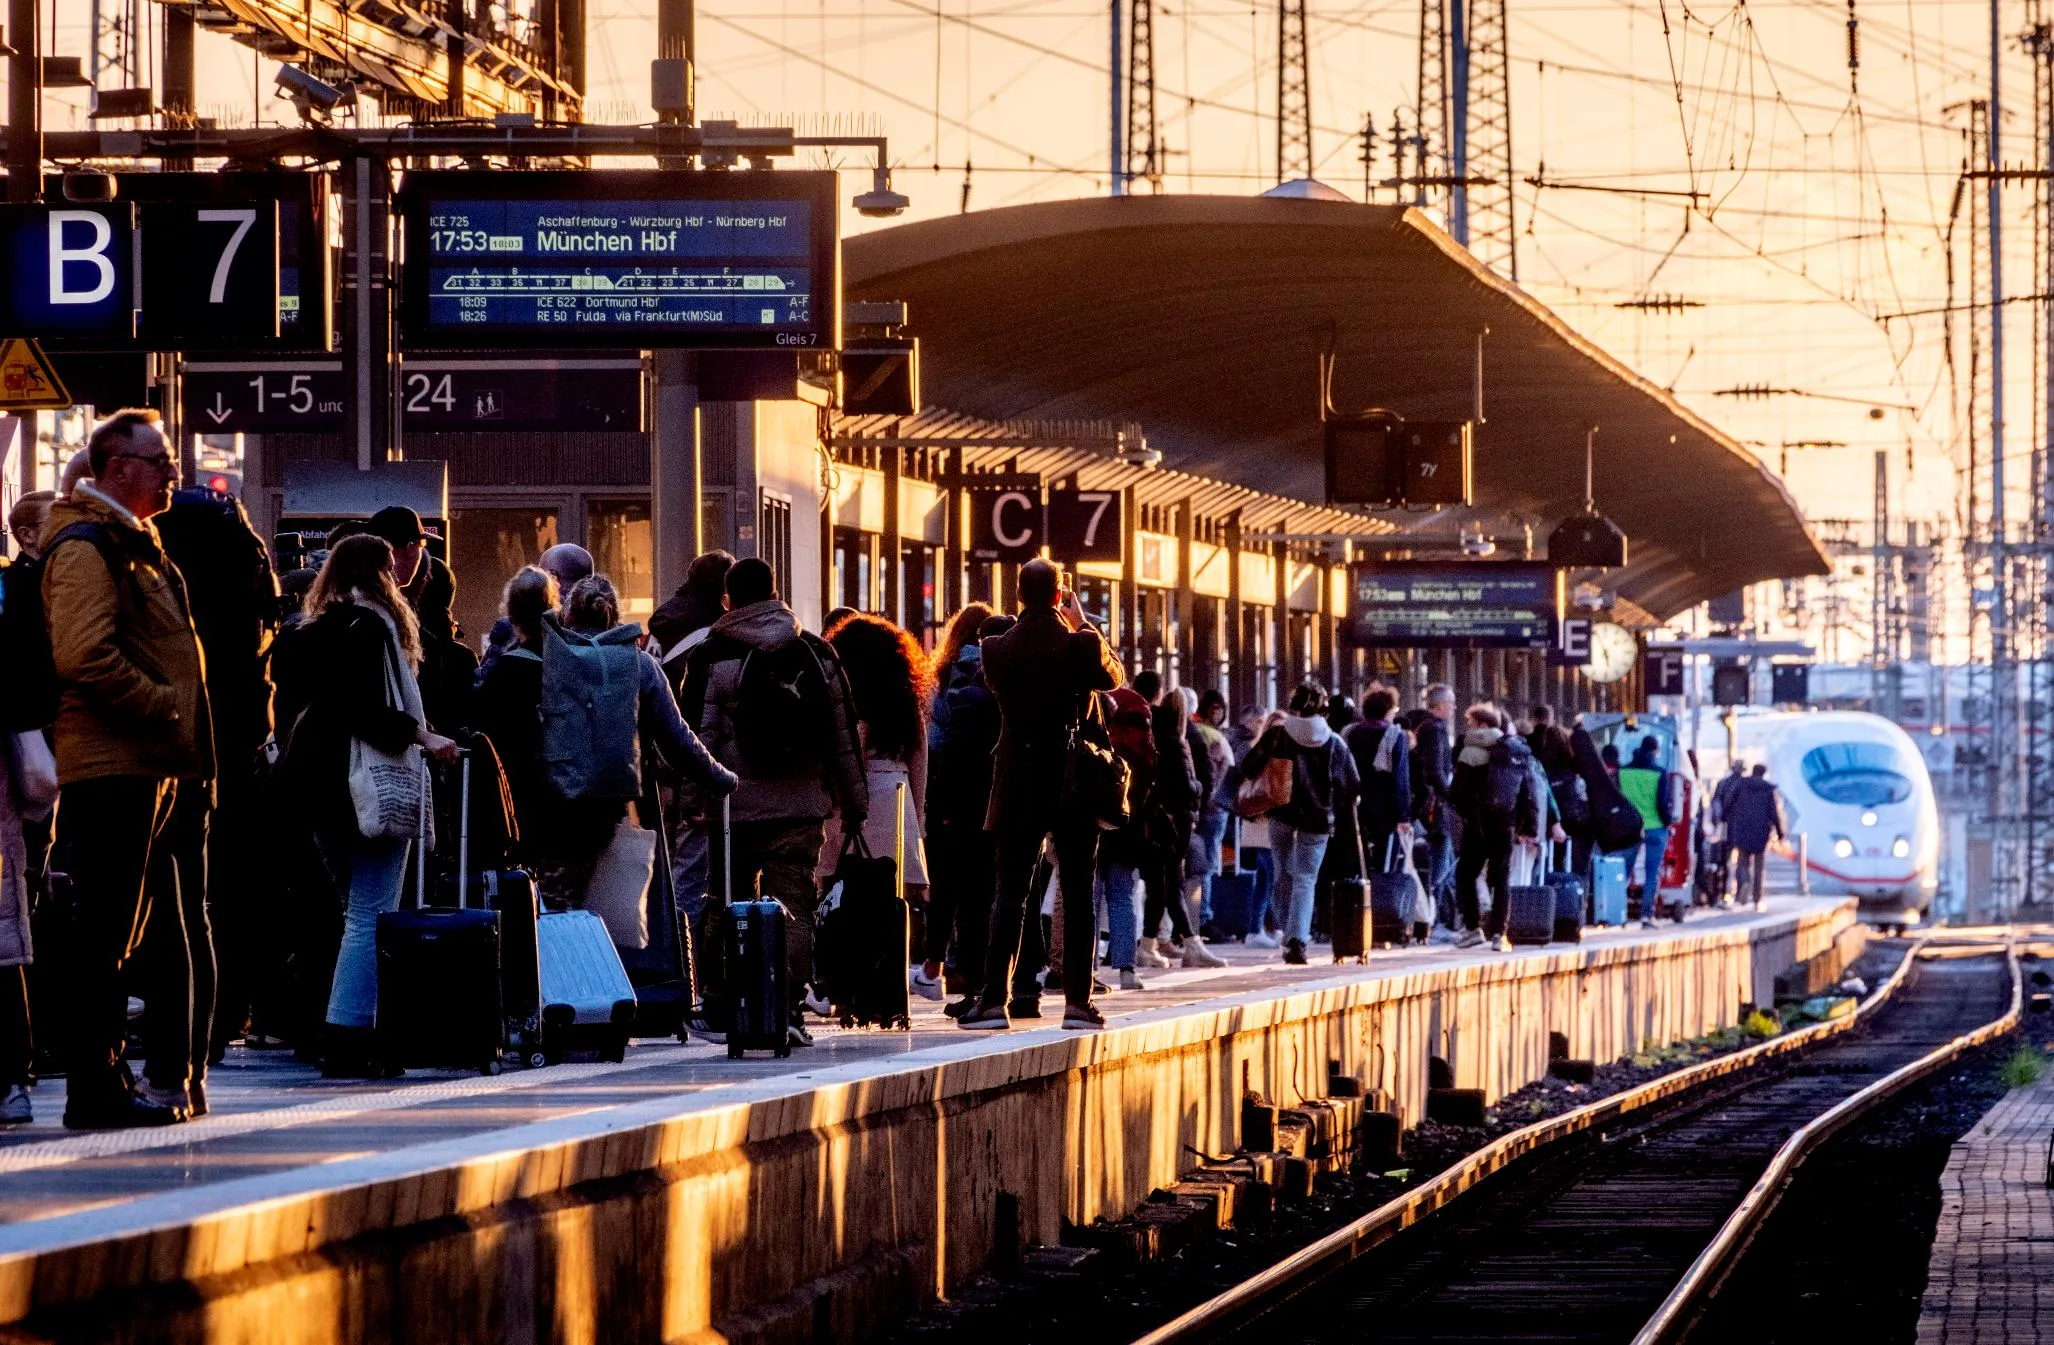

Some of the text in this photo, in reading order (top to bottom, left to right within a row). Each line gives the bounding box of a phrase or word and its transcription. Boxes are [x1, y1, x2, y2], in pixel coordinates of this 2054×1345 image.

[429, 216, 469, 227] ICE 725
[538, 216, 617, 228] Aschaffenburg
[630, 216, 682, 228] Würzburg
[685, 216, 703, 227] Hbf
[716, 216, 765, 228] Nürnberg
[768, 216, 787, 227] Hbf
[430, 231, 487, 251] 17:53
[492, 240, 521, 249] 18:03
[538, 231, 677, 251] München Hbf
[49, 210, 115, 304] B
[198, 209, 256, 303] 7
[472, 268, 730, 276] A B C D E F
[451, 278, 462, 287] 31
[469, 278, 481, 287] 32
[490, 278, 502, 287] 33
[555, 278, 566, 287] 37
[623, 278, 633, 287] 21
[640, 278, 652, 287] 22
[662, 278, 674, 287] 23
[726, 278, 738, 287] 27
[459, 298, 487, 308] 18:09
[537, 298, 660, 308] ICE 622 Dortmund Hbf
[790, 297, 809, 308] A-F
[280, 311, 298, 322] A-F
[459, 311, 487, 322] 18:26
[537, 311, 723, 322] RE 50 Fulda via Frankfurt(M)Süd
[789, 311, 809, 322] A-C
[776, 333, 817, 345] Gleis 7
[249, 375, 313, 413] 1-5
[399, 374, 456, 413] 24
[992, 492, 1032, 547] C
[1078, 493, 1112, 547] 7
[1564, 620, 1589, 657] E
[1660, 656, 1679, 688] F
